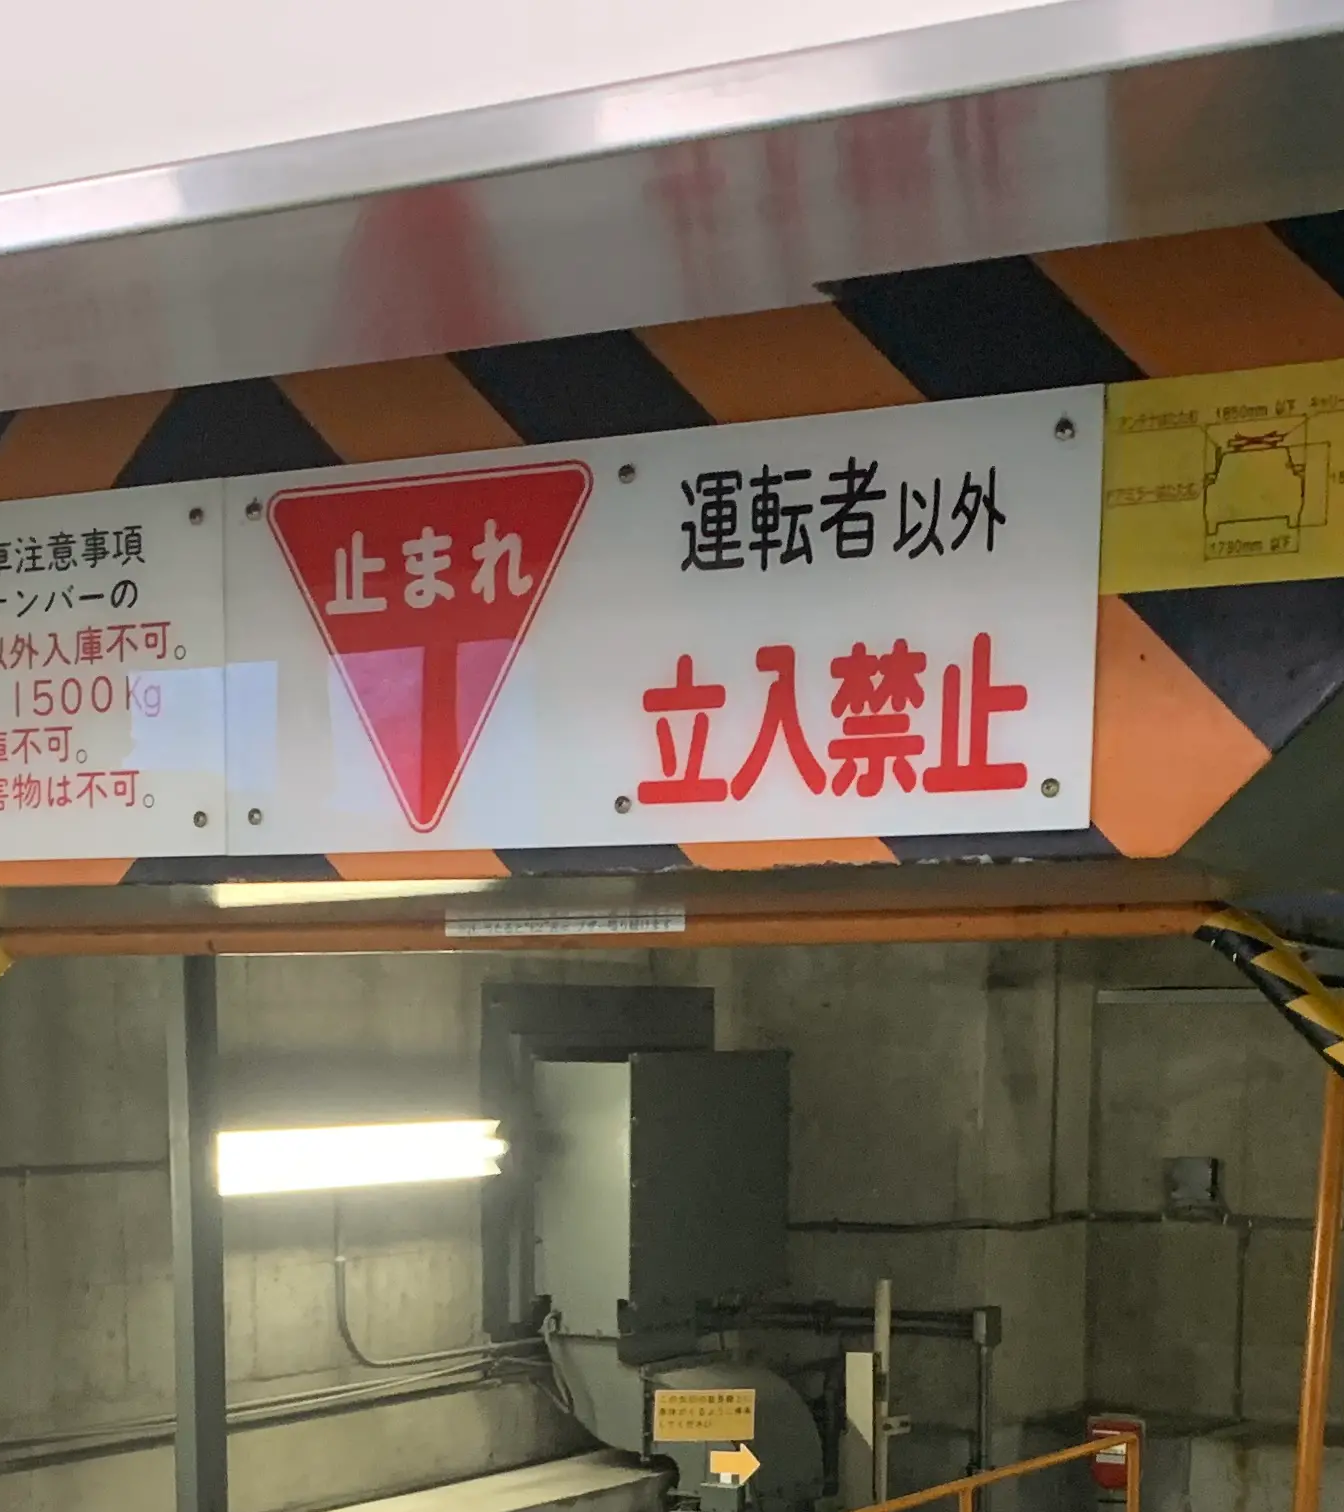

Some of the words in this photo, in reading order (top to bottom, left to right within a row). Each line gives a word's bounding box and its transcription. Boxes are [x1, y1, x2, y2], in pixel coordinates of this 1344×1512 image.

[324, 517, 533, 617] 止まれ
[681, 456, 1007, 573] 運転者以外
[636, 632, 1028, 805] 立入禁止
